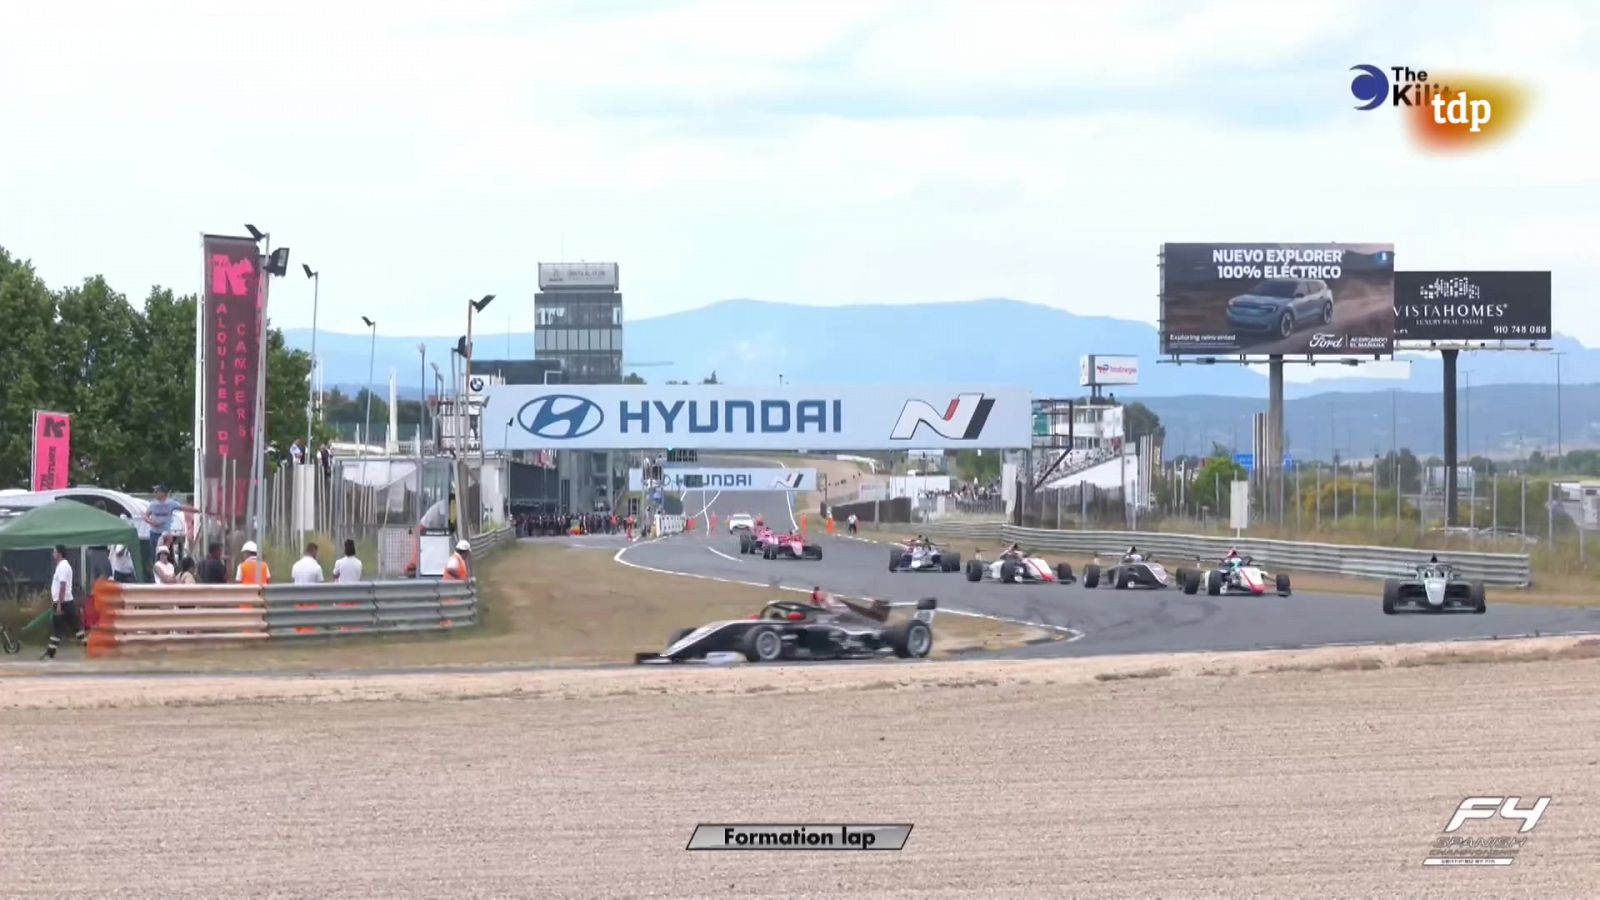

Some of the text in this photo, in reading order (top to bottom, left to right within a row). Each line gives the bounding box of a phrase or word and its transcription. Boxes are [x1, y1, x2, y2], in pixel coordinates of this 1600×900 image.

[1213, 249, 1264, 263] NUEVO
[1217, 260, 1342, 279] 100% ELÉCTRICO
[1493, 326, 1547, 334] 910 748 088
[1309, 332, 1343, 348] Ford
[235, 323, 248, 437] CAMPERS
[620, 400, 841, 433] HYUNDAI
